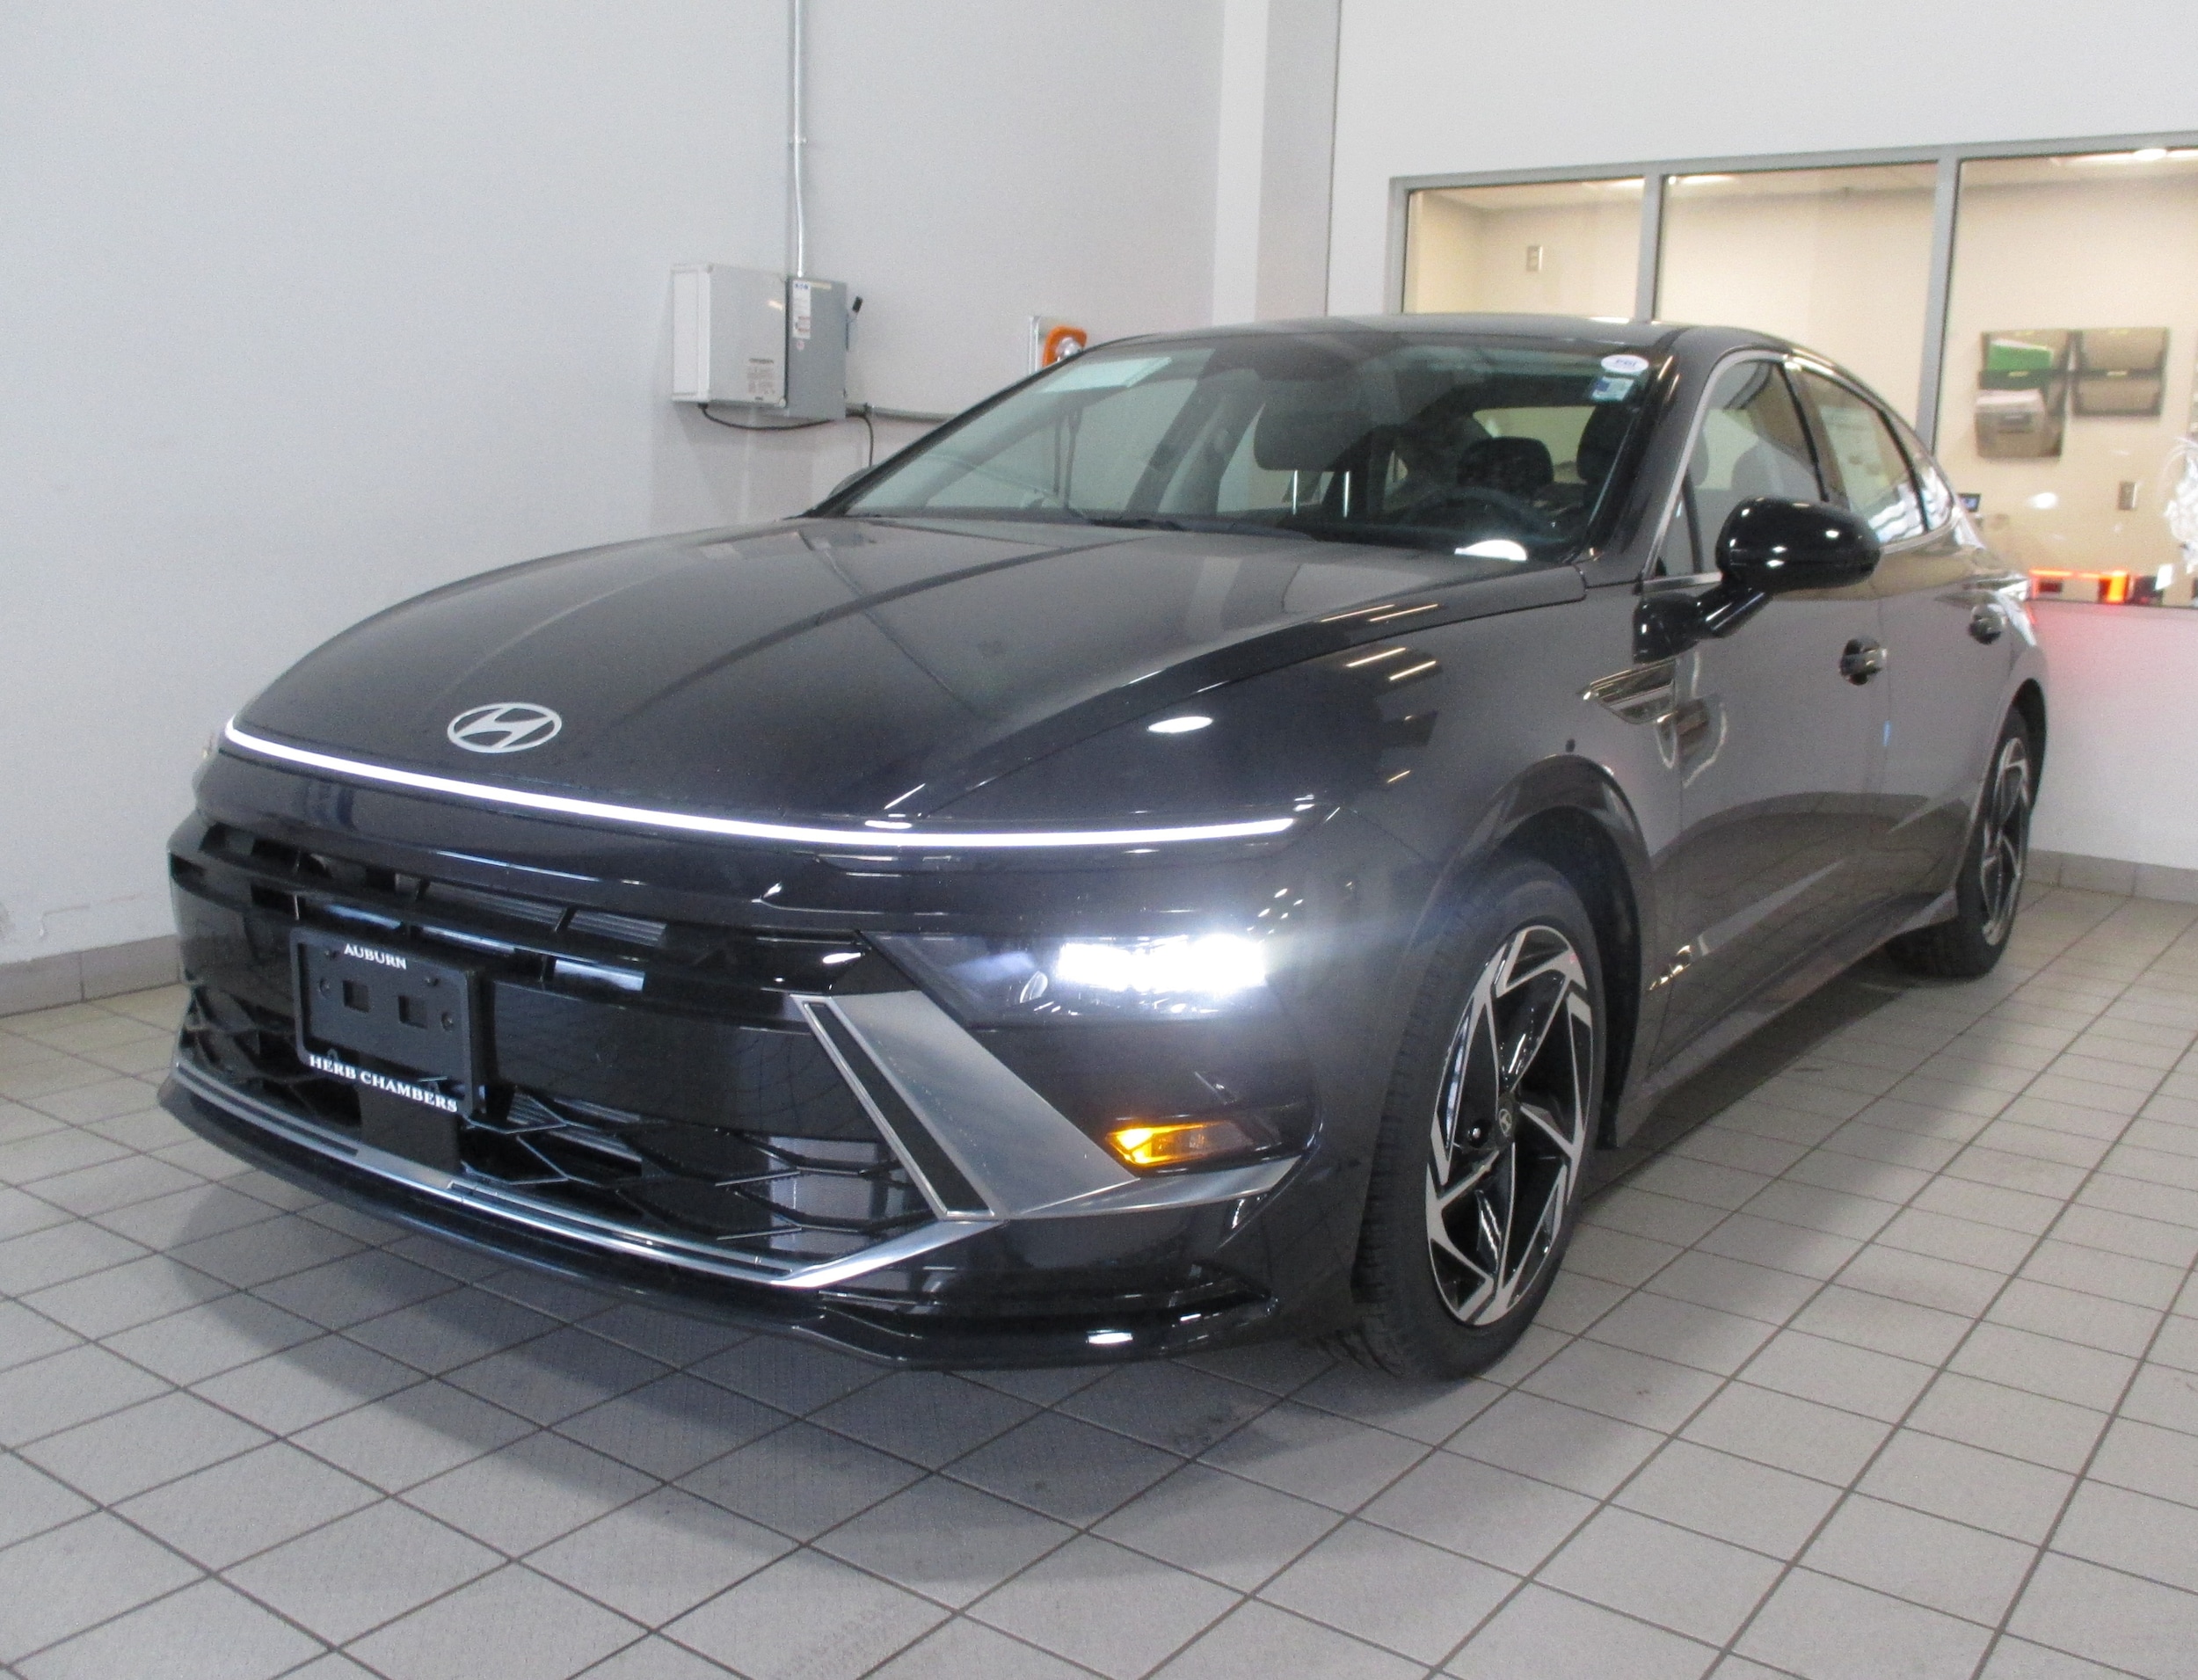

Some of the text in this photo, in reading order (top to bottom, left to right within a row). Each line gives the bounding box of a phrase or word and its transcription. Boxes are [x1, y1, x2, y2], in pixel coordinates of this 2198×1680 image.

[343, 943, 407, 970] AUBURN
[309, 1055, 458, 1113] HERB CHAMBERS
